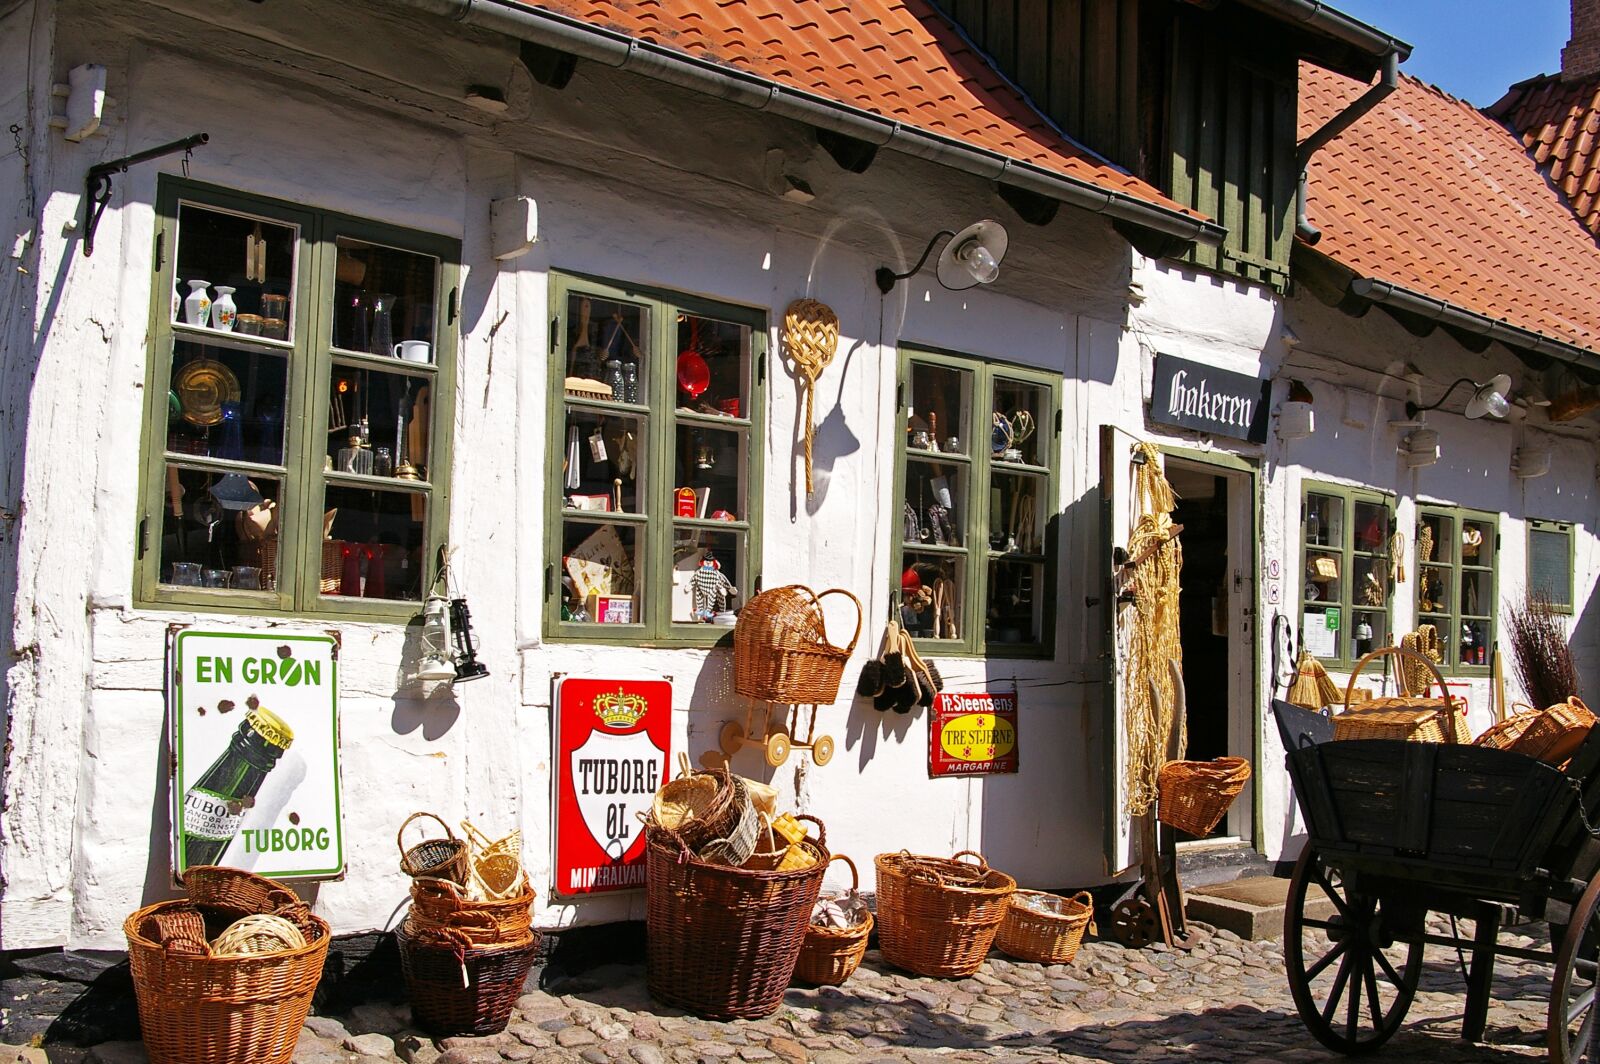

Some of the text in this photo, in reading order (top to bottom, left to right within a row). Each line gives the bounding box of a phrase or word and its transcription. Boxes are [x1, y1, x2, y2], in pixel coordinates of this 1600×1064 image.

[1168, 370, 1252, 428] Høkeren
[196, 656, 321, 687] EN GRØN
[945, 729, 1012, 745] TRE STJERNE
[579, 759, 658, 795] TUBORG
[947, 762, 1007, 772] MARGARINE
[606, 803, 629, 839] ØL
[242, 827, 330, 853] TUBORG
[570, 864, 646, 889] MINERALVAN
